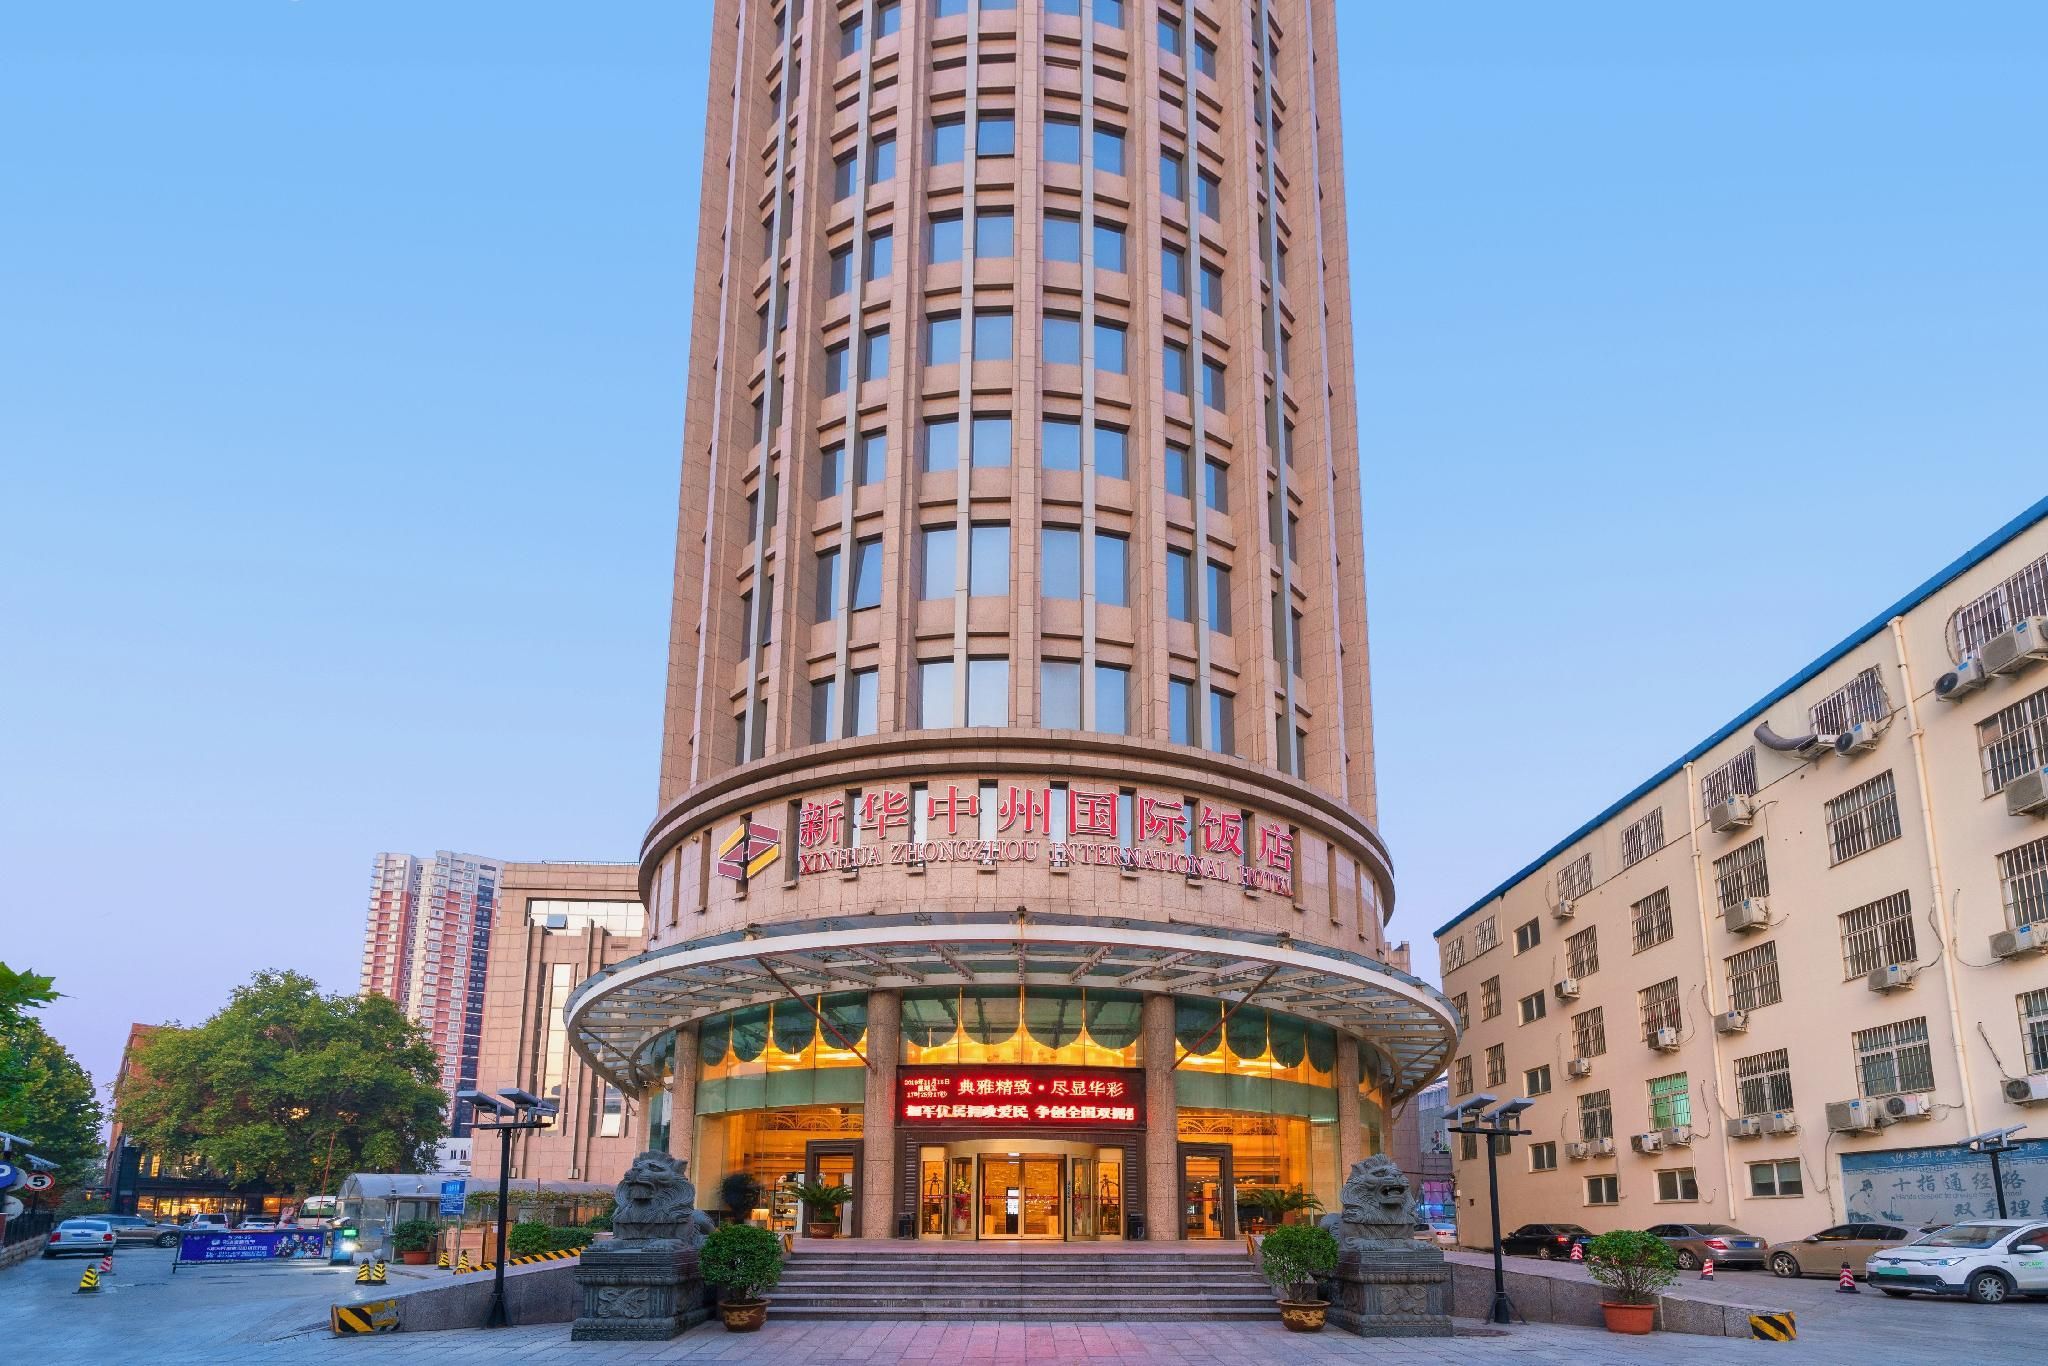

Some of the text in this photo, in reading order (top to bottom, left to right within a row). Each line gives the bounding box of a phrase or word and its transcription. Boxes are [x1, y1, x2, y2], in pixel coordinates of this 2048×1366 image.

[799, 785, 1294, 872] 新华中州国际饭店
[799, 839, 1294, 897] XINHUA ZHONGZHOU INTERNATIONAL HOTEL
[32, 1176, 46, 1188] 5
[1892, 1171, 2026, 1192] 十指通经络
